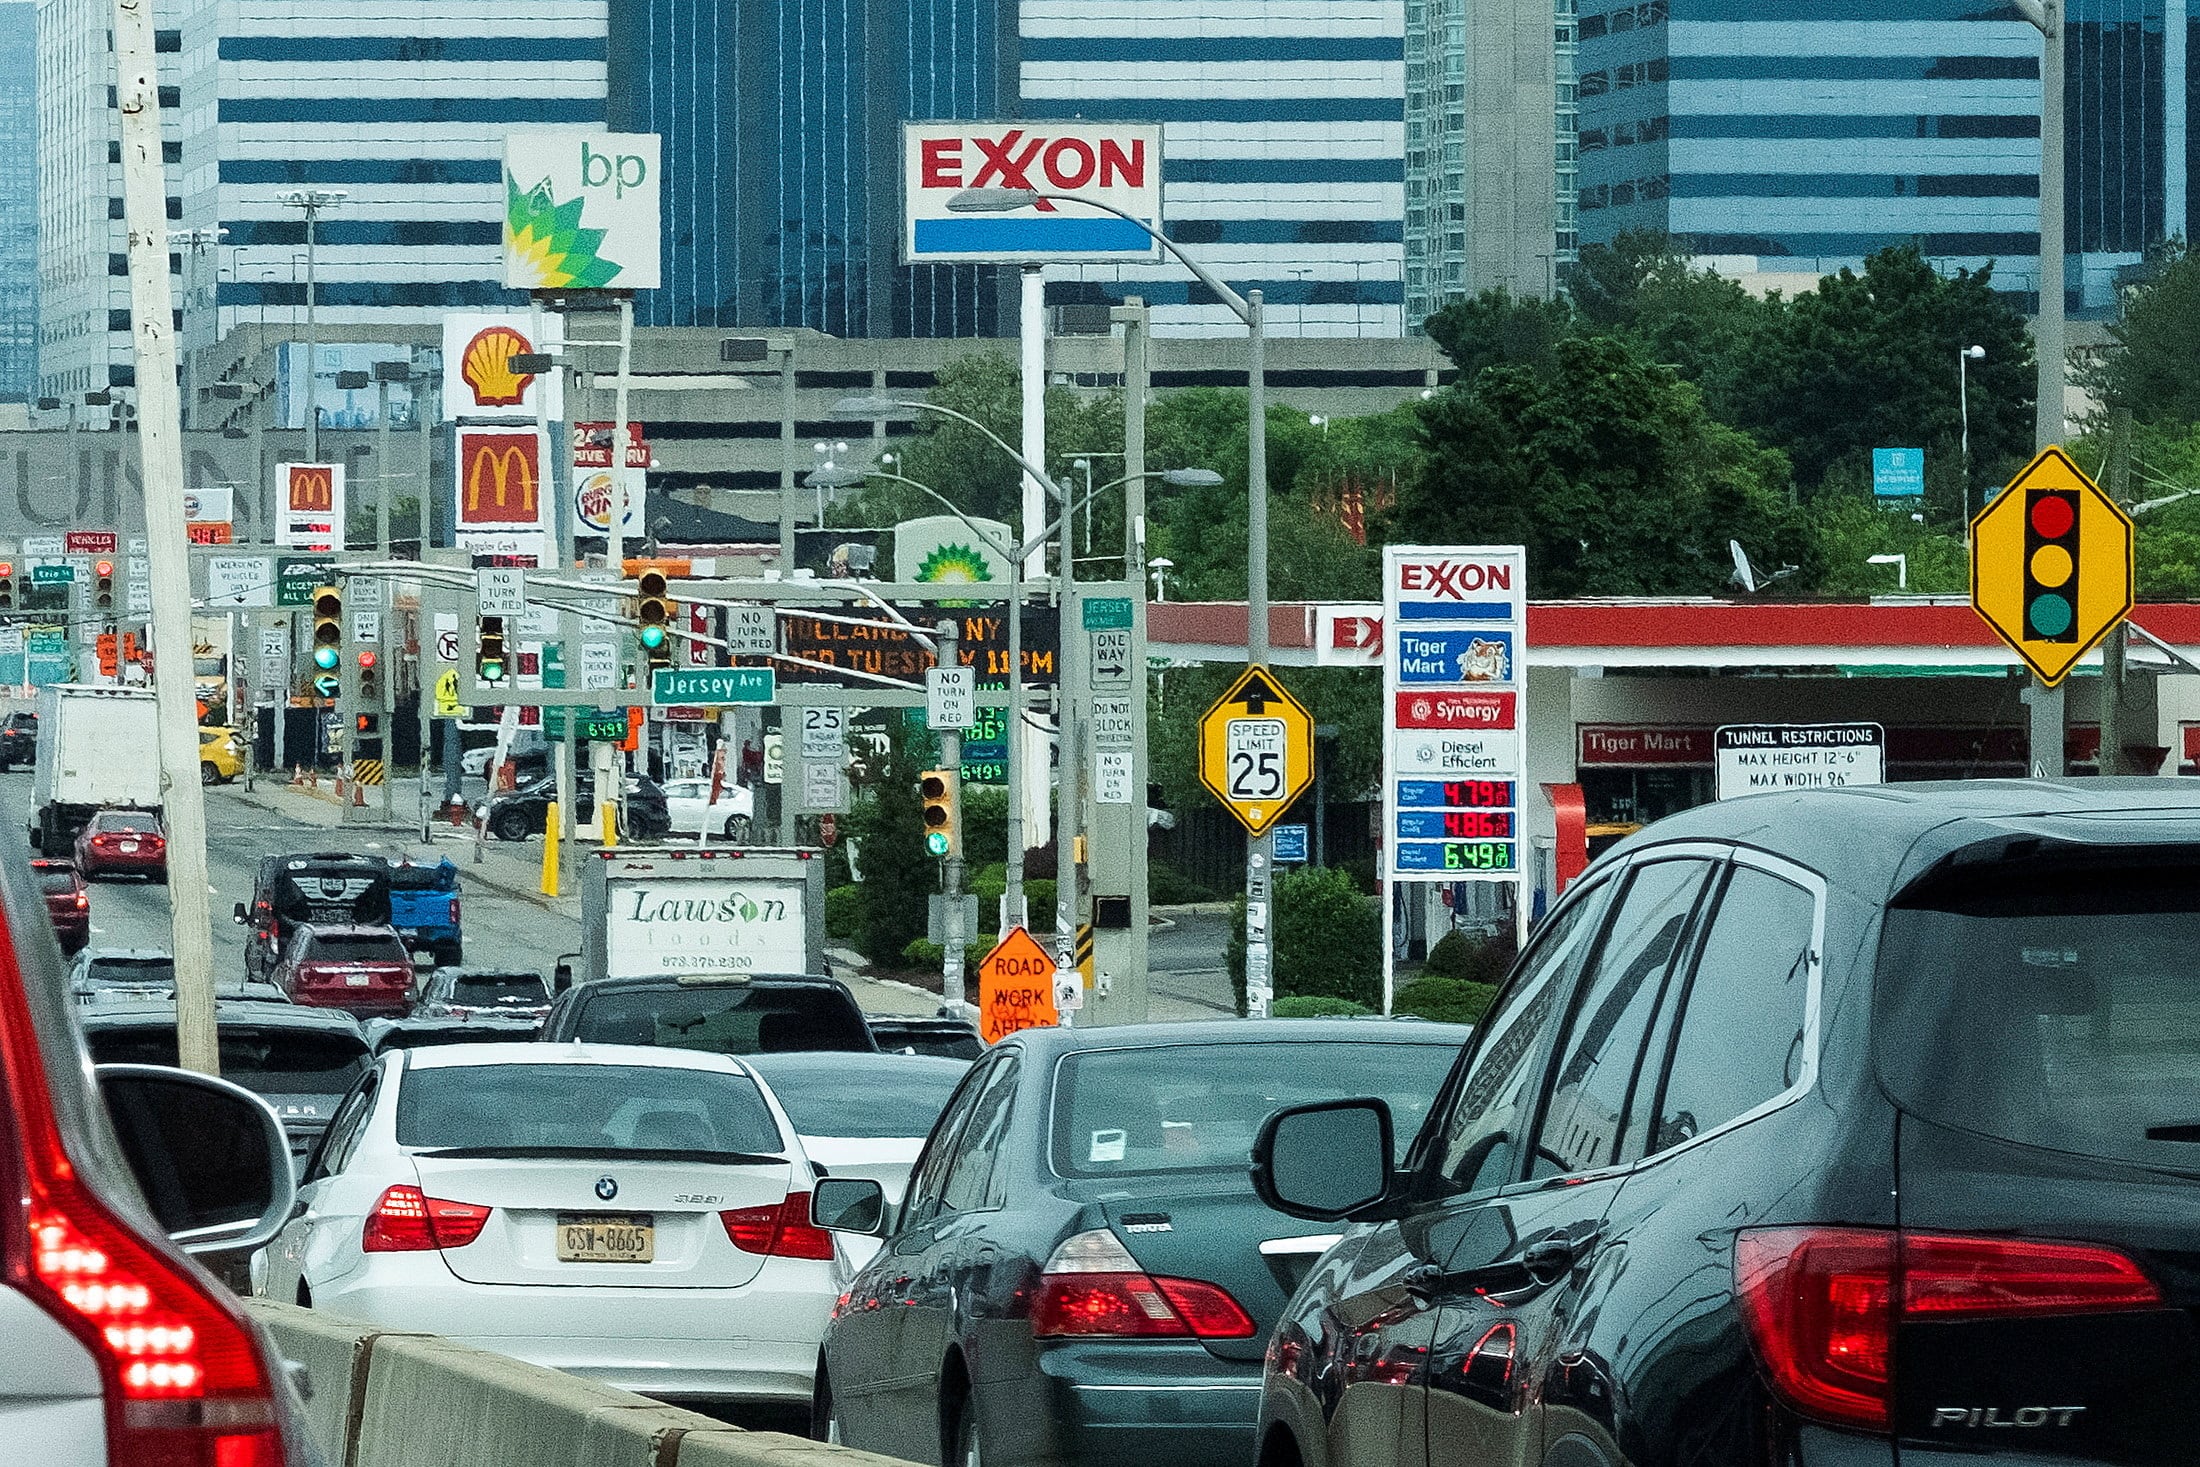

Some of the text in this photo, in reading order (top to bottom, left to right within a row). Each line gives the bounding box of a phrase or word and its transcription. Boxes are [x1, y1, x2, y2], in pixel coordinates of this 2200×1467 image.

[581, 141, 646, 200] bp
[921, 130, 1144, 212] EXXON
[1401, 560, 1510, 600] EXXON
[488, 587, 516, 597] TURN
[482, 601, 522, 610] ON RED
[1086, 601, 1129, 614] JERSEY
[741, 612, 760, 623] NO
[737, 625, 766, 636] TURN
[965, 617, 1001, 641] NY
[731, 638, 772, 648] ON RED
[1097, 635, 1125, 647] ONE
[1402, 638, 1447, 657] Tiger
[264, 643, 283, 655] 25
[1097, 649, 1126, 661] WAY
[1402, 659, 1446, 674] Mart
[664, 673, 762, 698] Jersey Ave
[940, 673, 961, 685] NO
[937, 687, 966, 697] TURN
[943, 700, 959, 710] ON
[1094, 703, 1130, 714] DO NOT
[939, 713, 962, 723] RED
[1437, 702, 1501, 722] Synergy
[806, 709, 840, 729] 25
[1094, 719, 1131, 732] BLOCK
[1233, 724, 1280, 737] SPEED
[1725, 729, 1874, 745] TUNNEL RESTRICTIONS
[1237, 738, 1274, 751] LIMIT
[1442, 741, 1484, 754] Diesel
[1588, 732, 1692, 753] Tiger Mart
[1104, 757, 1122, 766] NO
[1442, 756, 1496, 768] Efficient
[1738, 753, 1767, 766] MAX
[1772, 752, 1818, 765] HEIGHT
[1103, 769, 1125, 777] TURN
[1231, 753, 1280, 796] 25
[1750, 774, 1778, 787] MAX
[1784, 773, 1826, 786] WIDTH
[627, 890, 785, 923] Lawson
[995, 958, 1045, 976] ROAD
[995, 989, 1044, 1006] WORK
[1931, 1407, 2087, 1427] PILOT
